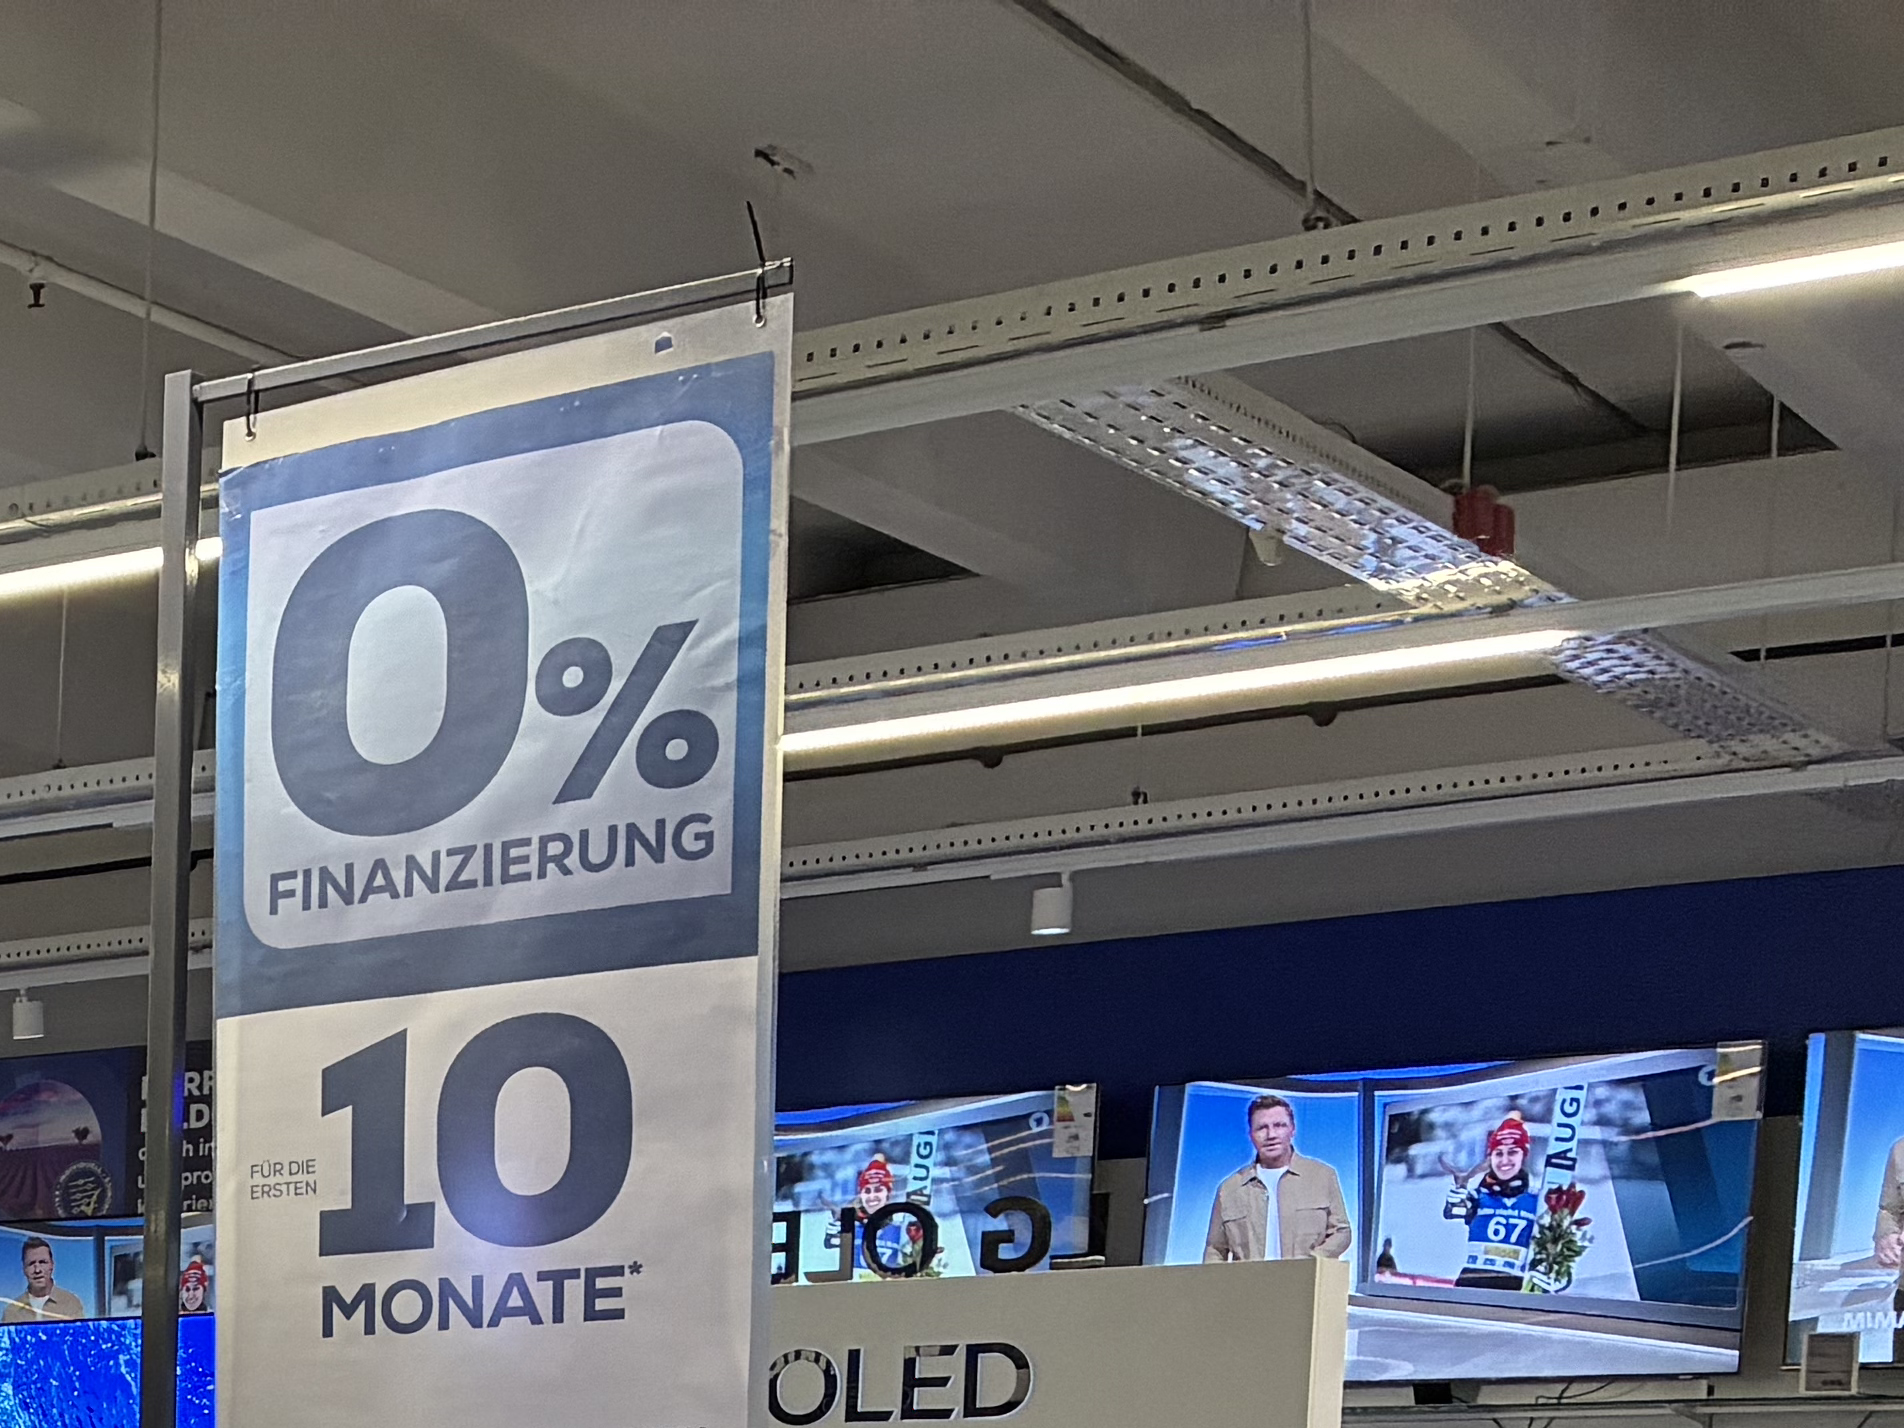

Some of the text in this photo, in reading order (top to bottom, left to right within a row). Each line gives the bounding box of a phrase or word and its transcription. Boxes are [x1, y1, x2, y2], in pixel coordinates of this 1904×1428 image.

[271, 508, 720, 836] 0%
[269, 812, 714, 916] FINANZIERUNG
[251, 1159, 316, 1179] FÜR DIE
[319, 1011, 633, 1256] 10
[251, 1180, 316, 1200] ERSTEN
[1487, 1218, 1527, 1243] 67
[768, 1342, 1032, 1426] OLED
